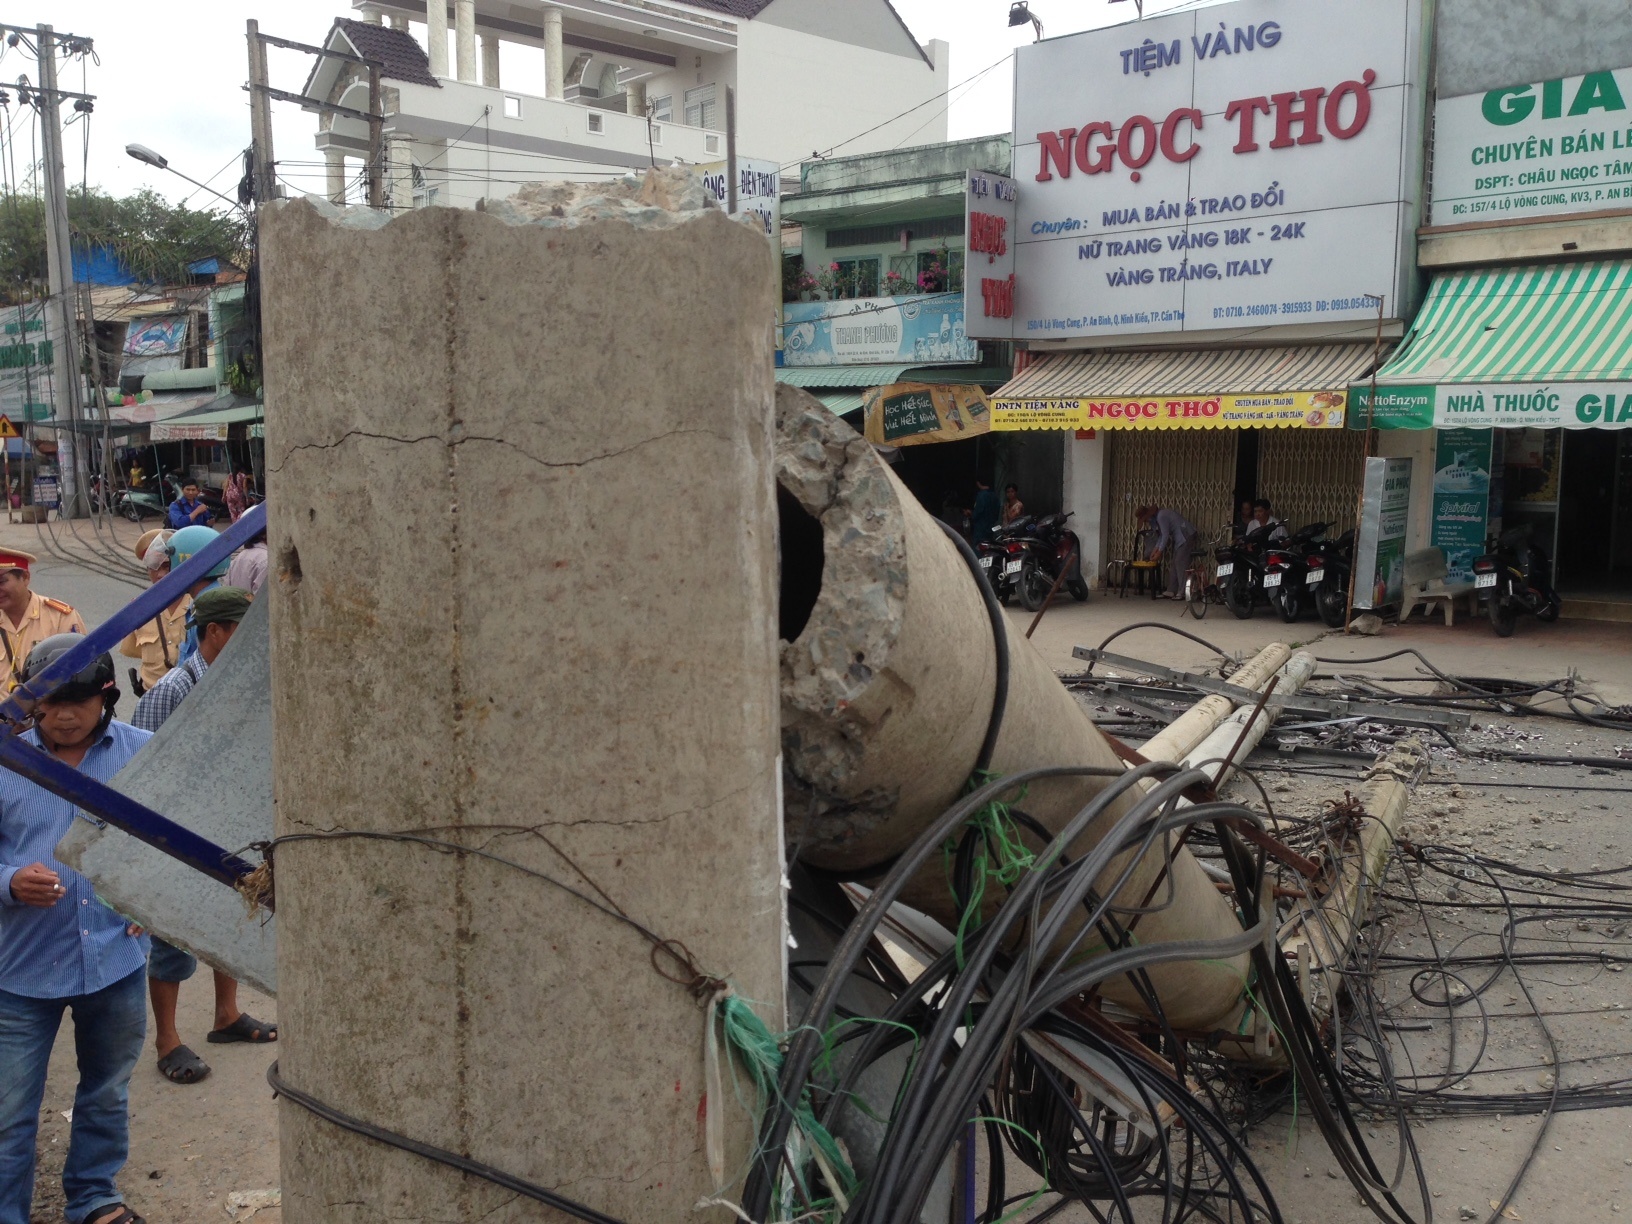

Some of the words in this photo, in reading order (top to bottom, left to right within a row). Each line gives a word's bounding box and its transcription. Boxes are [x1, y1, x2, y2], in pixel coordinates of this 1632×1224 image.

[1120, 38, 1180, 76] TIỆM
[1191, 21, 1282, 60] VÀNG
[1481, 70, 1626, 126] GIA
[1035, 107, 1202, 182] NGỌC
[1224, 68, 1376, 154] THƠ
[1471, 135, 1553, 165] CHUYÊN
[1561, 129, 1605, 155] BÁN
[741, 164, 757, 200] ĐIỆN
[757, 170, 776, 203] THOẠI
[1475, 174, 1514, 190] DSPT:
[1518, 168, 1556, 186] CHÂU
[1560, 165, 1599, 182] NGỌC
[1102, 207, 1141, 226] MUA
[1145, 200, 1180, 221] BÁN
[1185, 200, 1196, 215] &
[1200, 194, 1246, 215] TRAO
[1250, 181, 1284, 207] ĐỔI
[1453, 203, 1467, 215] ĐC:
[1470, 200, 1496, 213] 157/4
[1499, 197, 1511, 211] LỘ
[1514, 194, 1538, 208] VÒNG
[1541, 193, 1567, 206] CUNG,
[1571, 191, 1592, 204] KV3,
[1595, 190, 1604, 201] P.
[1607, 188, 1620, 199] AN
[1078, 240, 1102, 260] NỮ
[1106, 236, 1162, 257] TRANG
[1167, 230, 1218, 251] VÀNG
[1224, 228, 1251, 246] 18K
[1271, 222, 1305, 241] 24K
[1106, 268, 1154, 287] VÀNG
[1159, 257, 1222, 284] TRẮNG,
[1226, 258, 1273, 278] ITALY
[995, 402, 1022, 410] DNTN
[1024, 399, 1047, 411] TIỆM
[1050, 398, 1079, 409] VÀNG
[1088, 400, 1158, 422] NGỌC
[1165, 396, 1221, 417] THƠ
[1447, 390, 1485, 413] NHÀ
[1493, 386, 1560, 412] THUỐC
